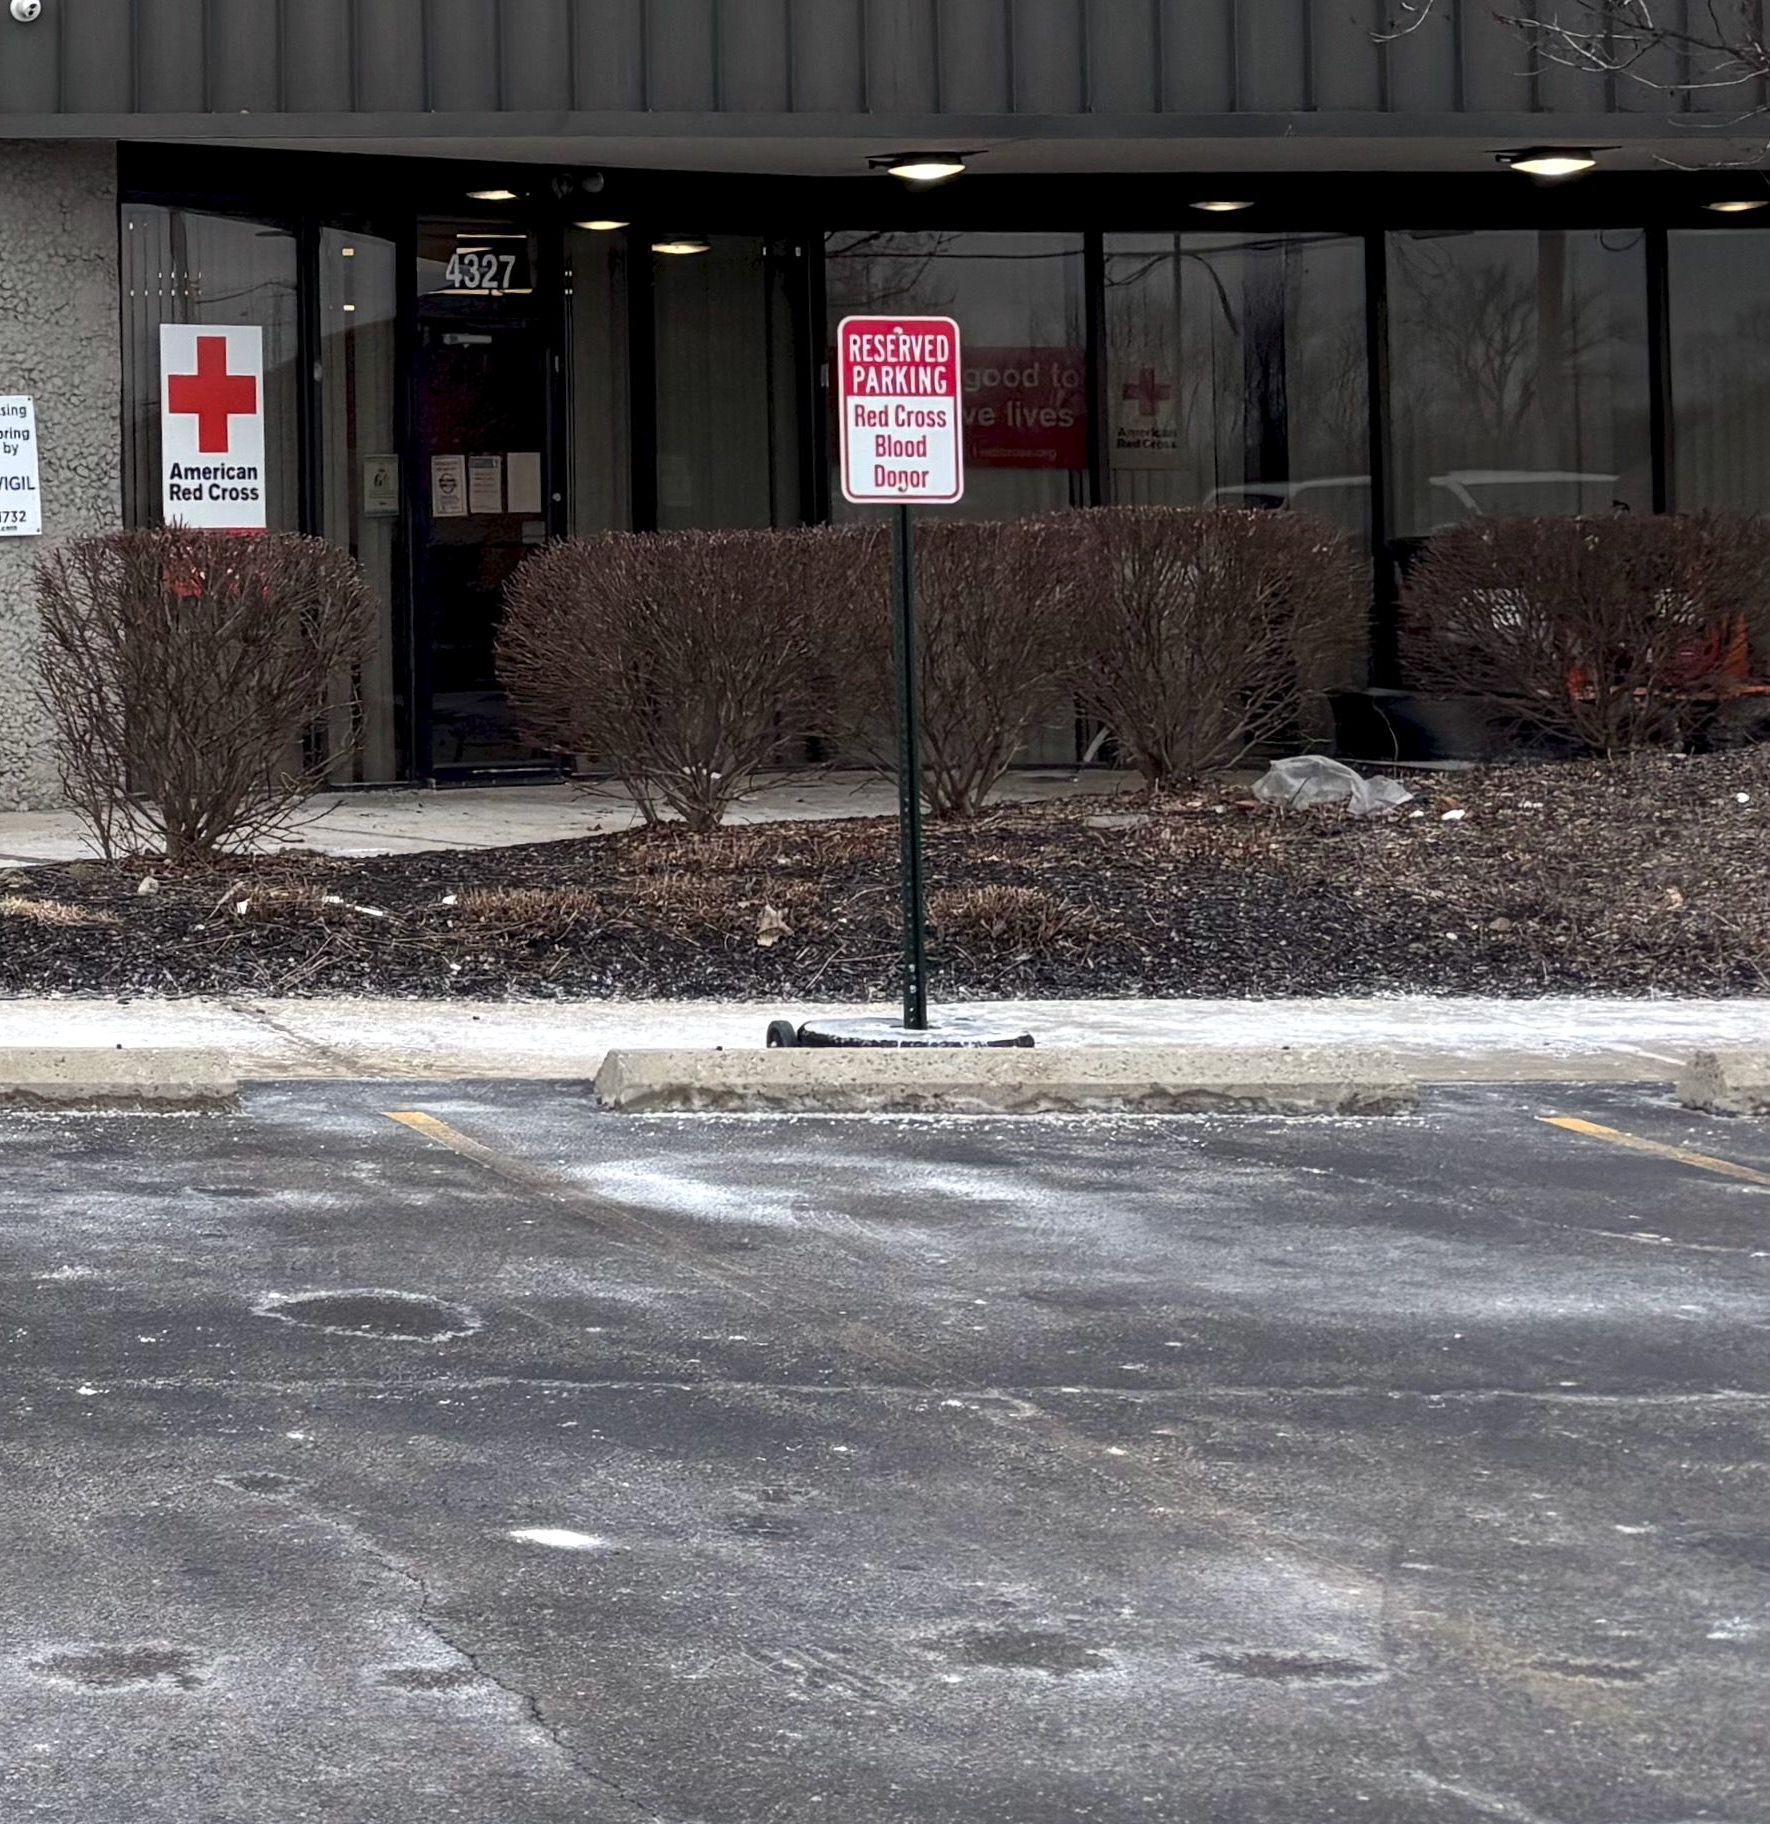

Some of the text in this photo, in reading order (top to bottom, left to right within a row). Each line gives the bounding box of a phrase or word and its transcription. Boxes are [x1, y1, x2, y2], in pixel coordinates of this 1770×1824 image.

[446, 254, 516, 288] 4327
[849, 334, 949, 362] RESERVED
[853, 366, 947, 394] PARKING
[964, 362, 1078, 391] good to
[854, 404, 947, 428] Red Cross
[964, 401, 1074, 427] ve lives
[3, 442, 19, 456] by
[875, 435, 926, 457] Blood
[1117, 439, 1141, 448] Red
[169, 462, 258, 480] American
[875, 464, 929, 488] Donor
[169, 483, 259, 501] Red Cross
